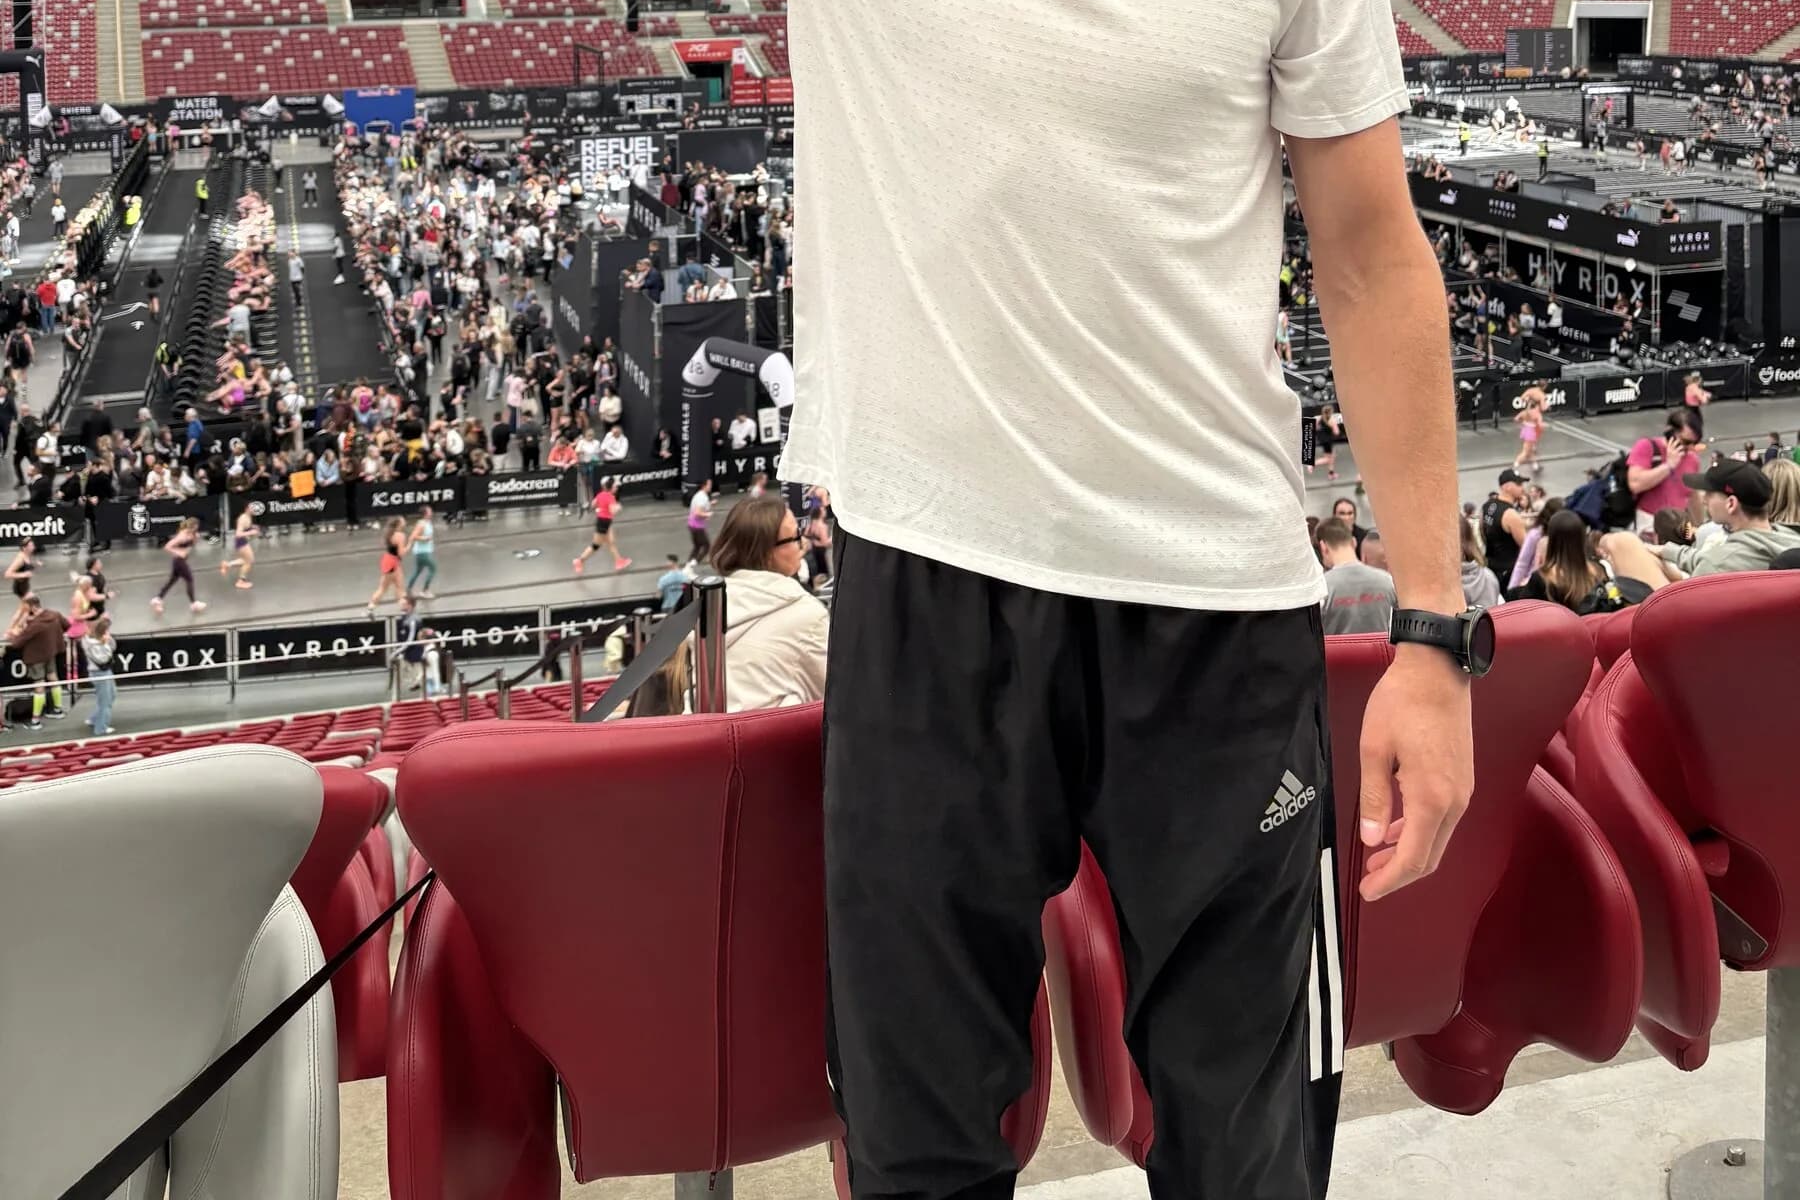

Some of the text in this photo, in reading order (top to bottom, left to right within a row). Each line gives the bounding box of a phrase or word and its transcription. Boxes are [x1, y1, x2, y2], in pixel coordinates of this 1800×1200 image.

[175, 98, 217, 110] WATER
[170, 108, 222, 121] STATION
[581, 136, 660, 156] REFUEL
[1670, 231, 1710, 244] HYROX
[1528, 252, 1646, 304] HYROX
[730, 358, 756, 374] BALLS
[1512, 388, 1566, 409] azfit
[488, 477, 559, 494] Sudocrem
[269, 498, 327, 513] Therabody
[0, 515, 66, 537] mazfit
[435, 624, 530, 648] YROX
[250, 636, 375, 661] HYROX
[118, 647, 216, 672] YROX
[1260, 785, 1316, 833] adidas
